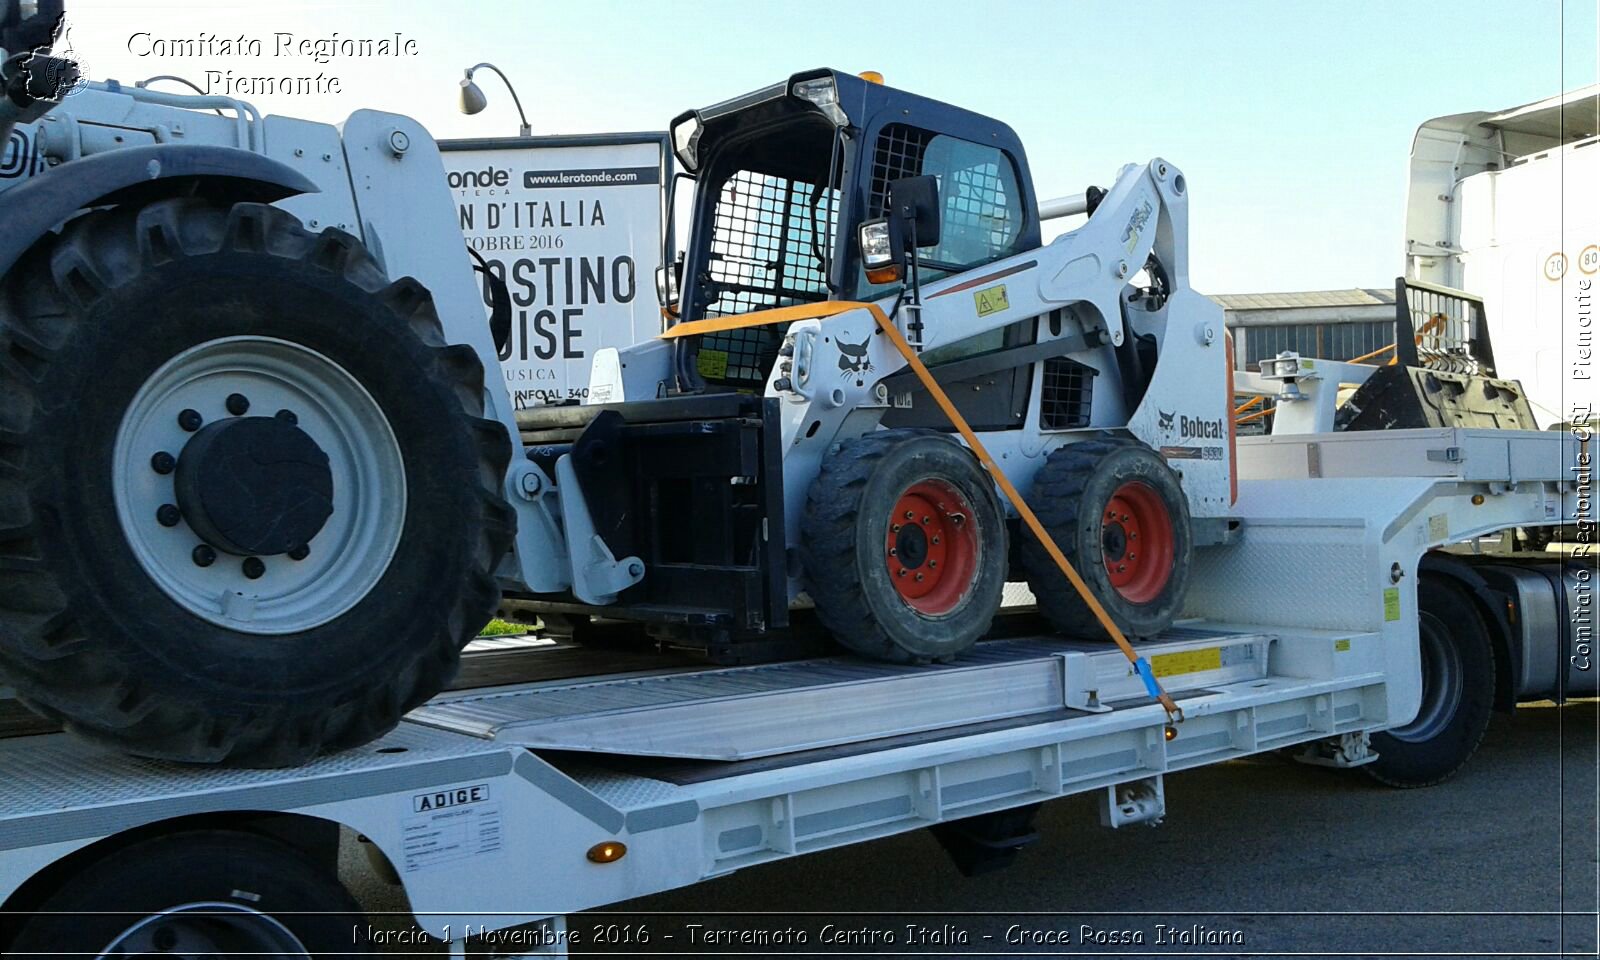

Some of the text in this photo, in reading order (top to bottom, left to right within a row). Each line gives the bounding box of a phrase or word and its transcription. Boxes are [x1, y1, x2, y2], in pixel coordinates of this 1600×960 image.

[445, 166, 509, 189] onde
[529, 171, 637, 185] www.lerotonde.com
[460, 189, 510, 197] TECA
[487, 199, 606, 230] D'ITALIA
[529, 234, 564, 250] 2016
[1584, 252, 1598, 266] 80
[506, 368, 557, 381] USICA
[568, 387, 590, 399] 340
[1180, 415, 1223, 440] Bobcat
[420, 787, 482, 811] ADIGE
